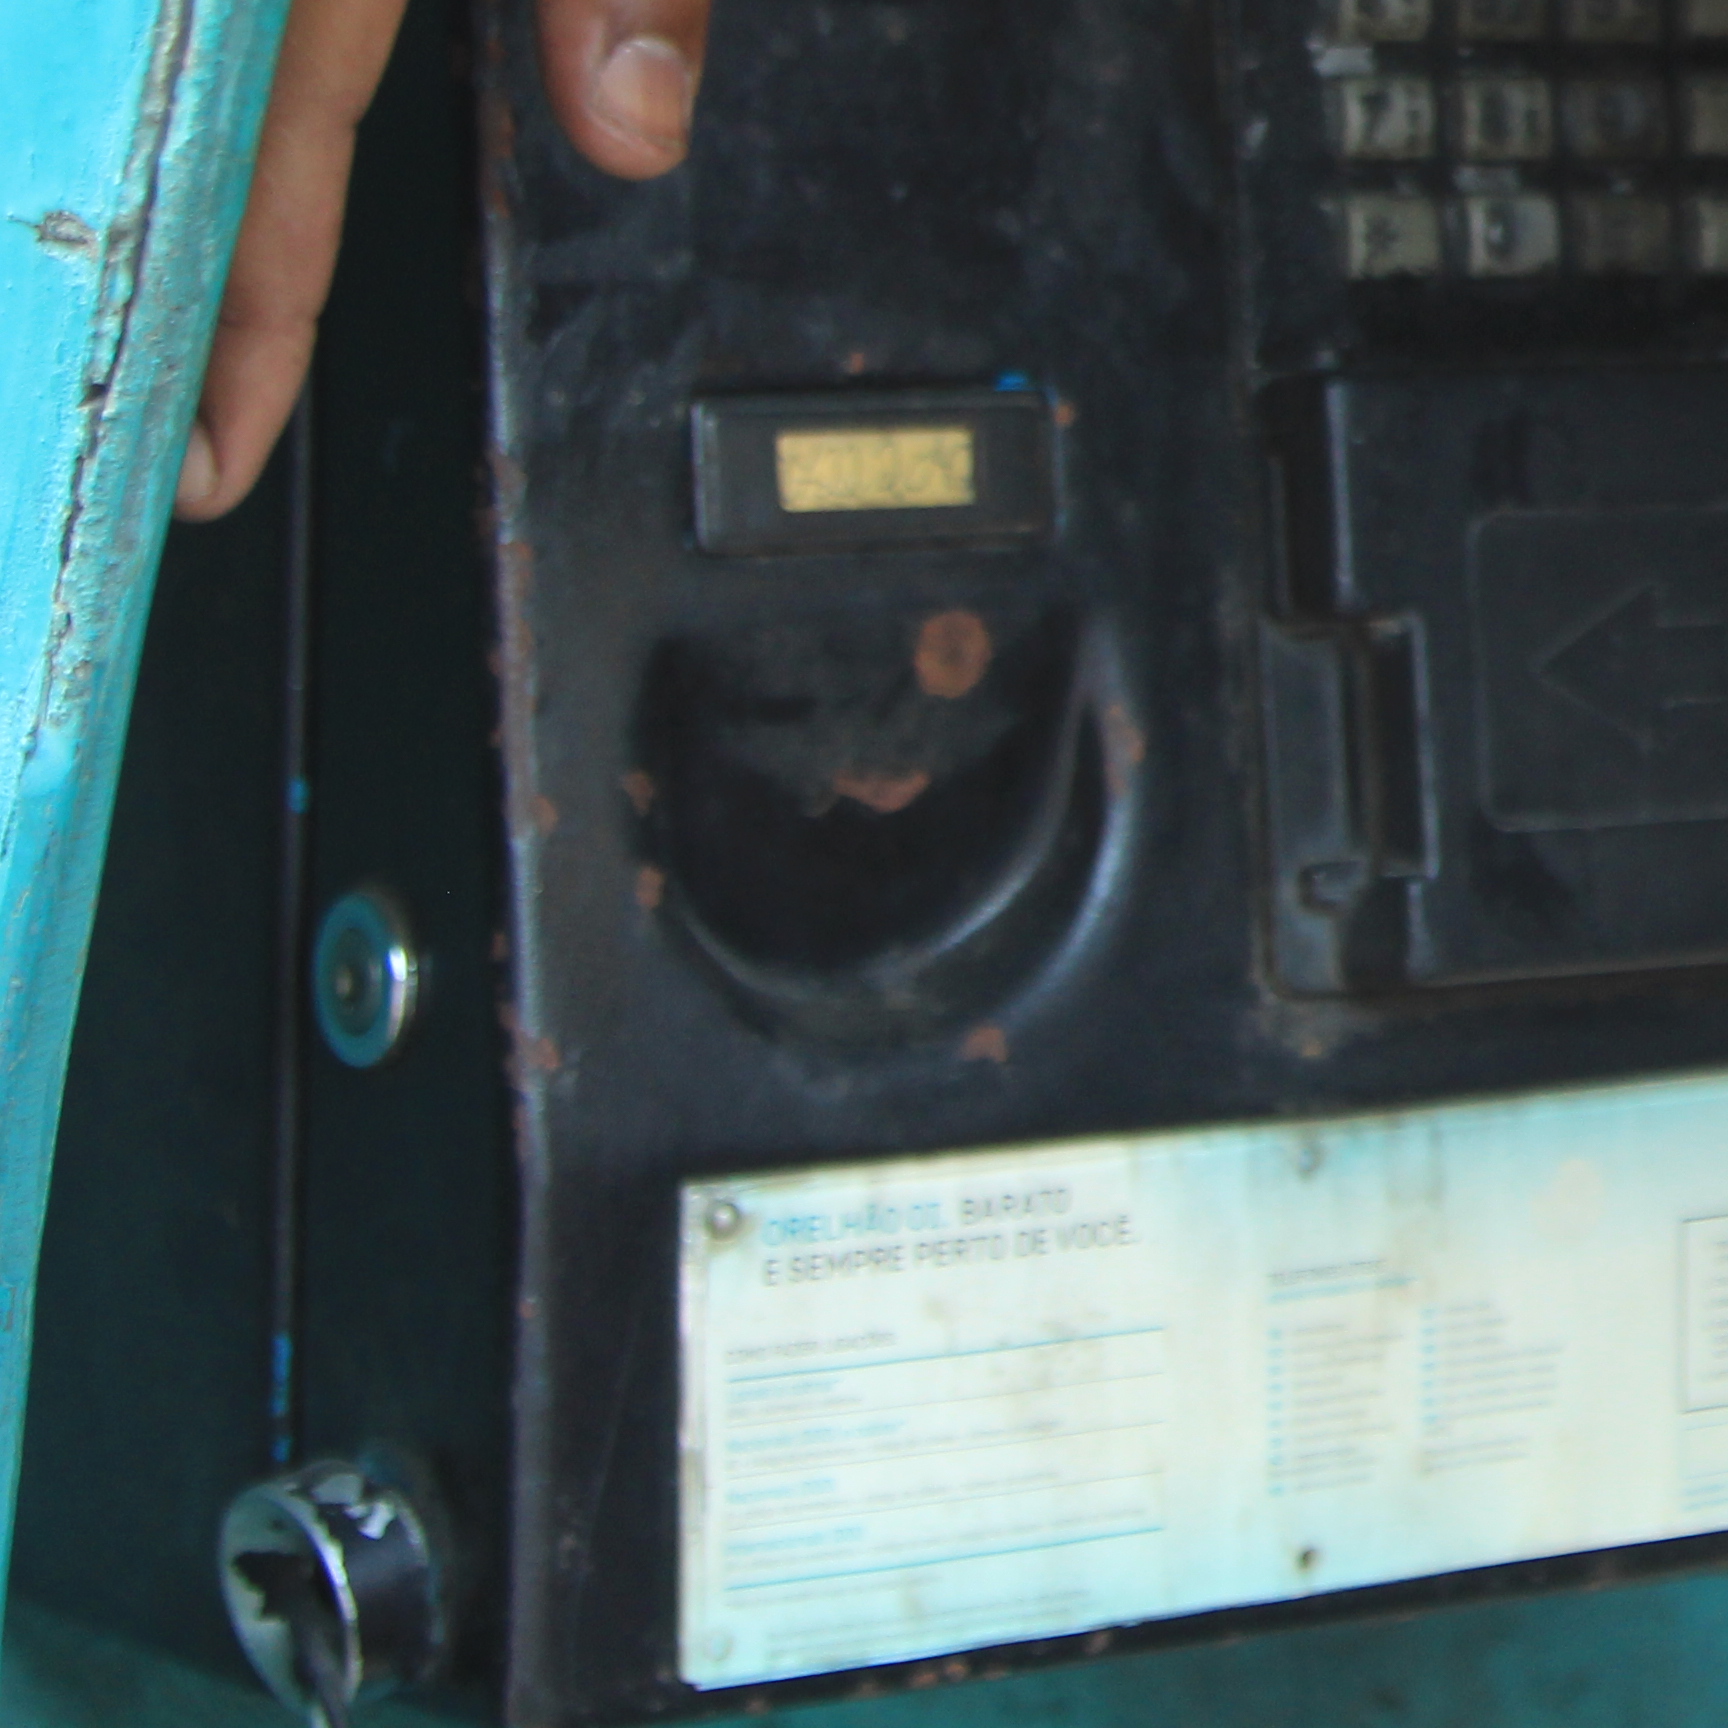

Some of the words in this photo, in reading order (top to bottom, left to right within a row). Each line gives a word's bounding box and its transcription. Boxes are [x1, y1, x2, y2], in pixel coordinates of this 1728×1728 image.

[960, 1186, 1072, 1227] BARATO
[762, 1256, 782, 1289] E
[786, 1244, 906, 1285] SEMPRE
[913, 1231, 1005, 1269] PERTO
[1011, 1226, 1051, 1260] DE
